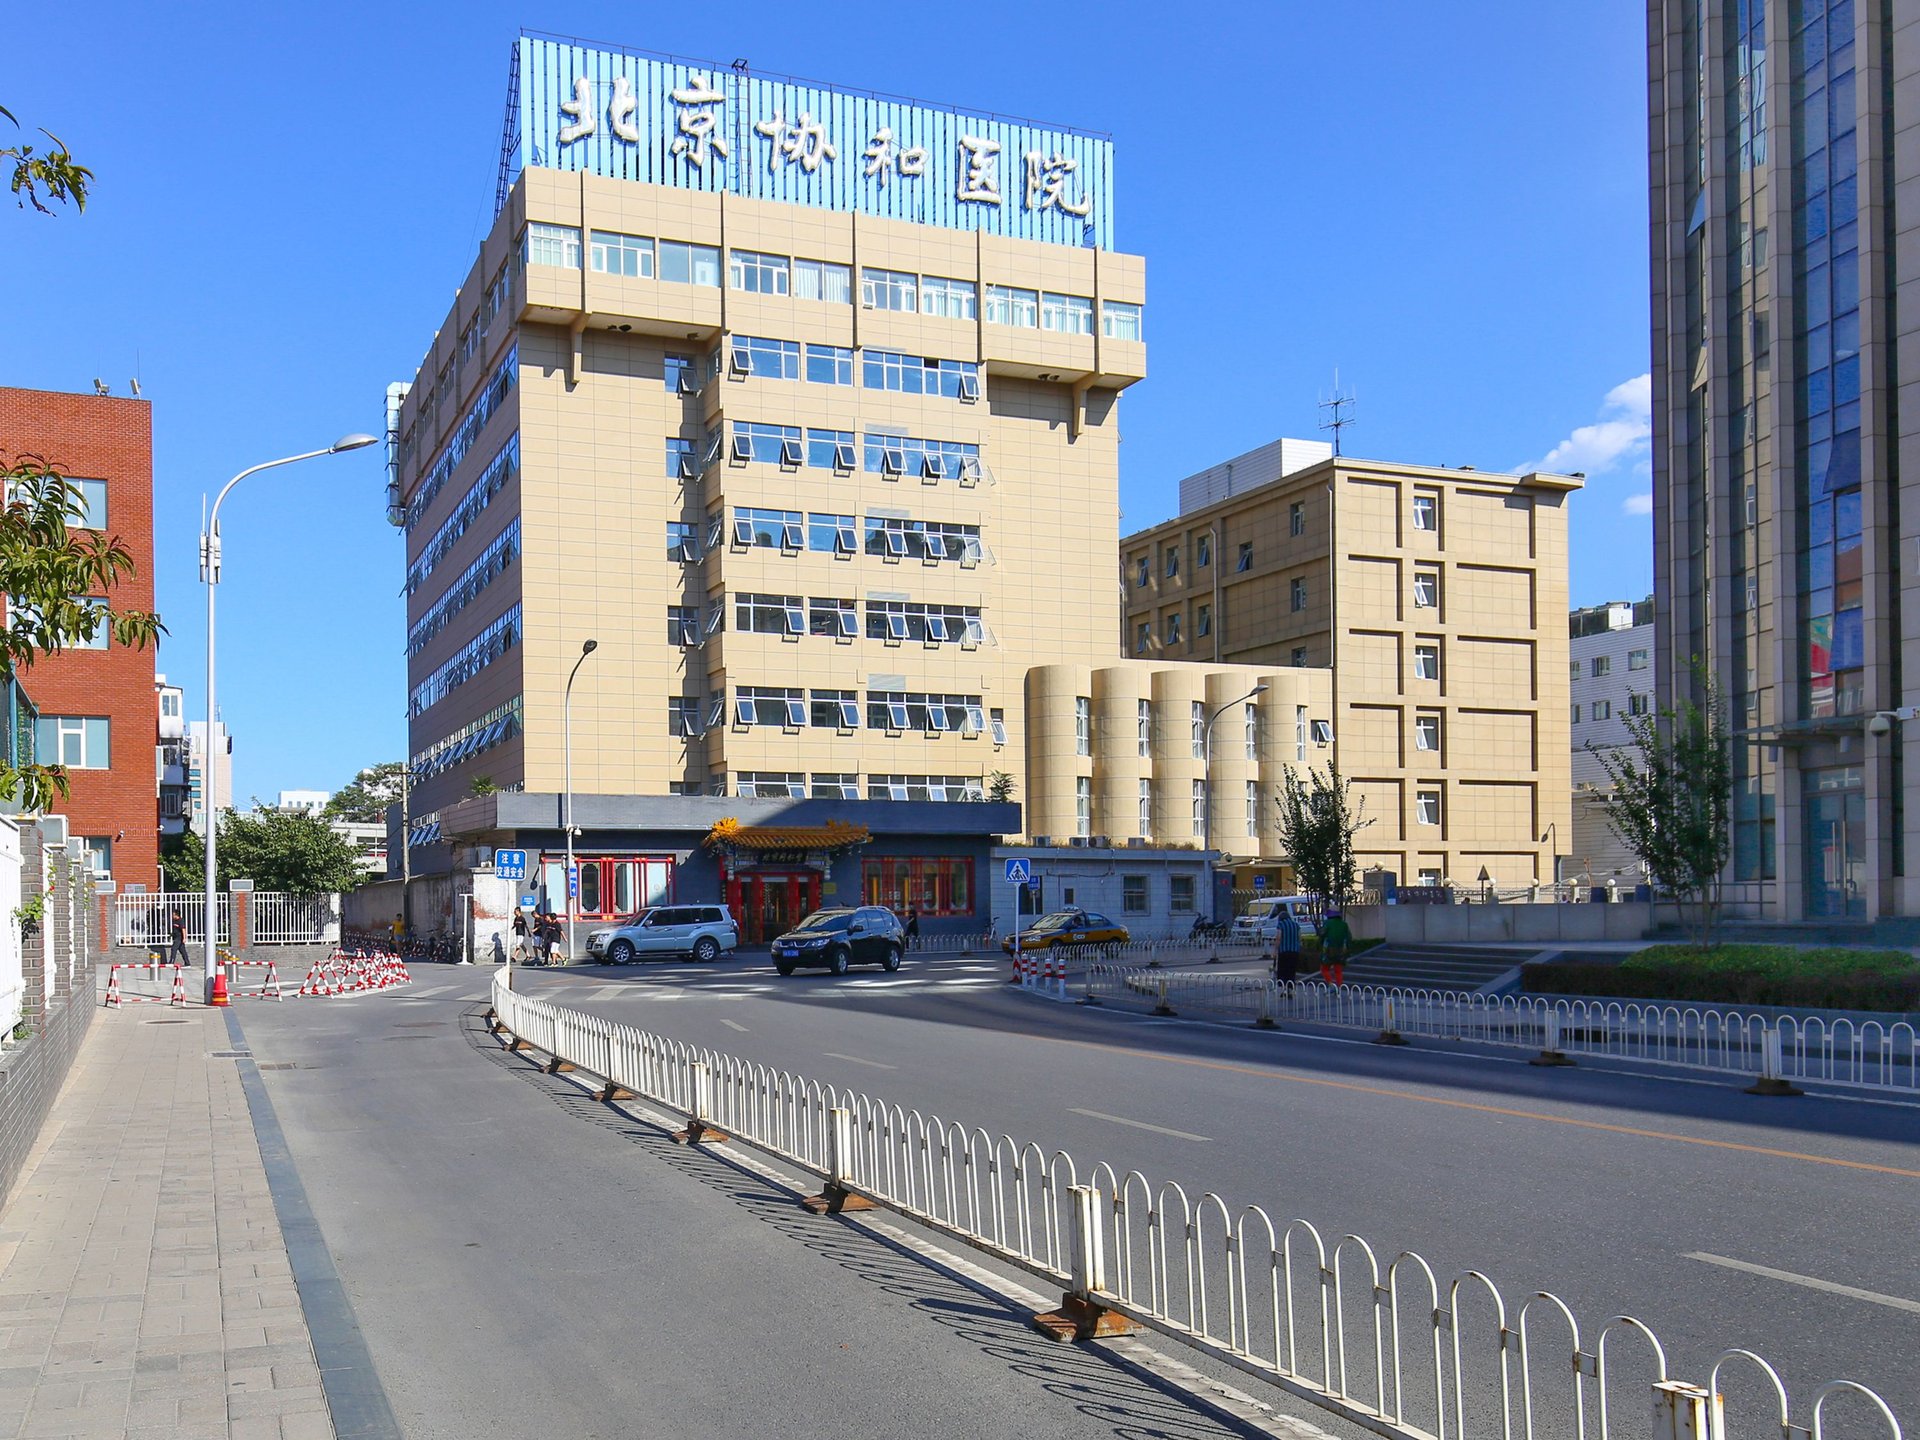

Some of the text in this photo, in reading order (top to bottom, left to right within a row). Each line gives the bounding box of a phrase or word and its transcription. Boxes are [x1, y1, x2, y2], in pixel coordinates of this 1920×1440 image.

[560, 76, 1091, 216] 北京协和医院
[497, 866, 524, 878] 交通安全
